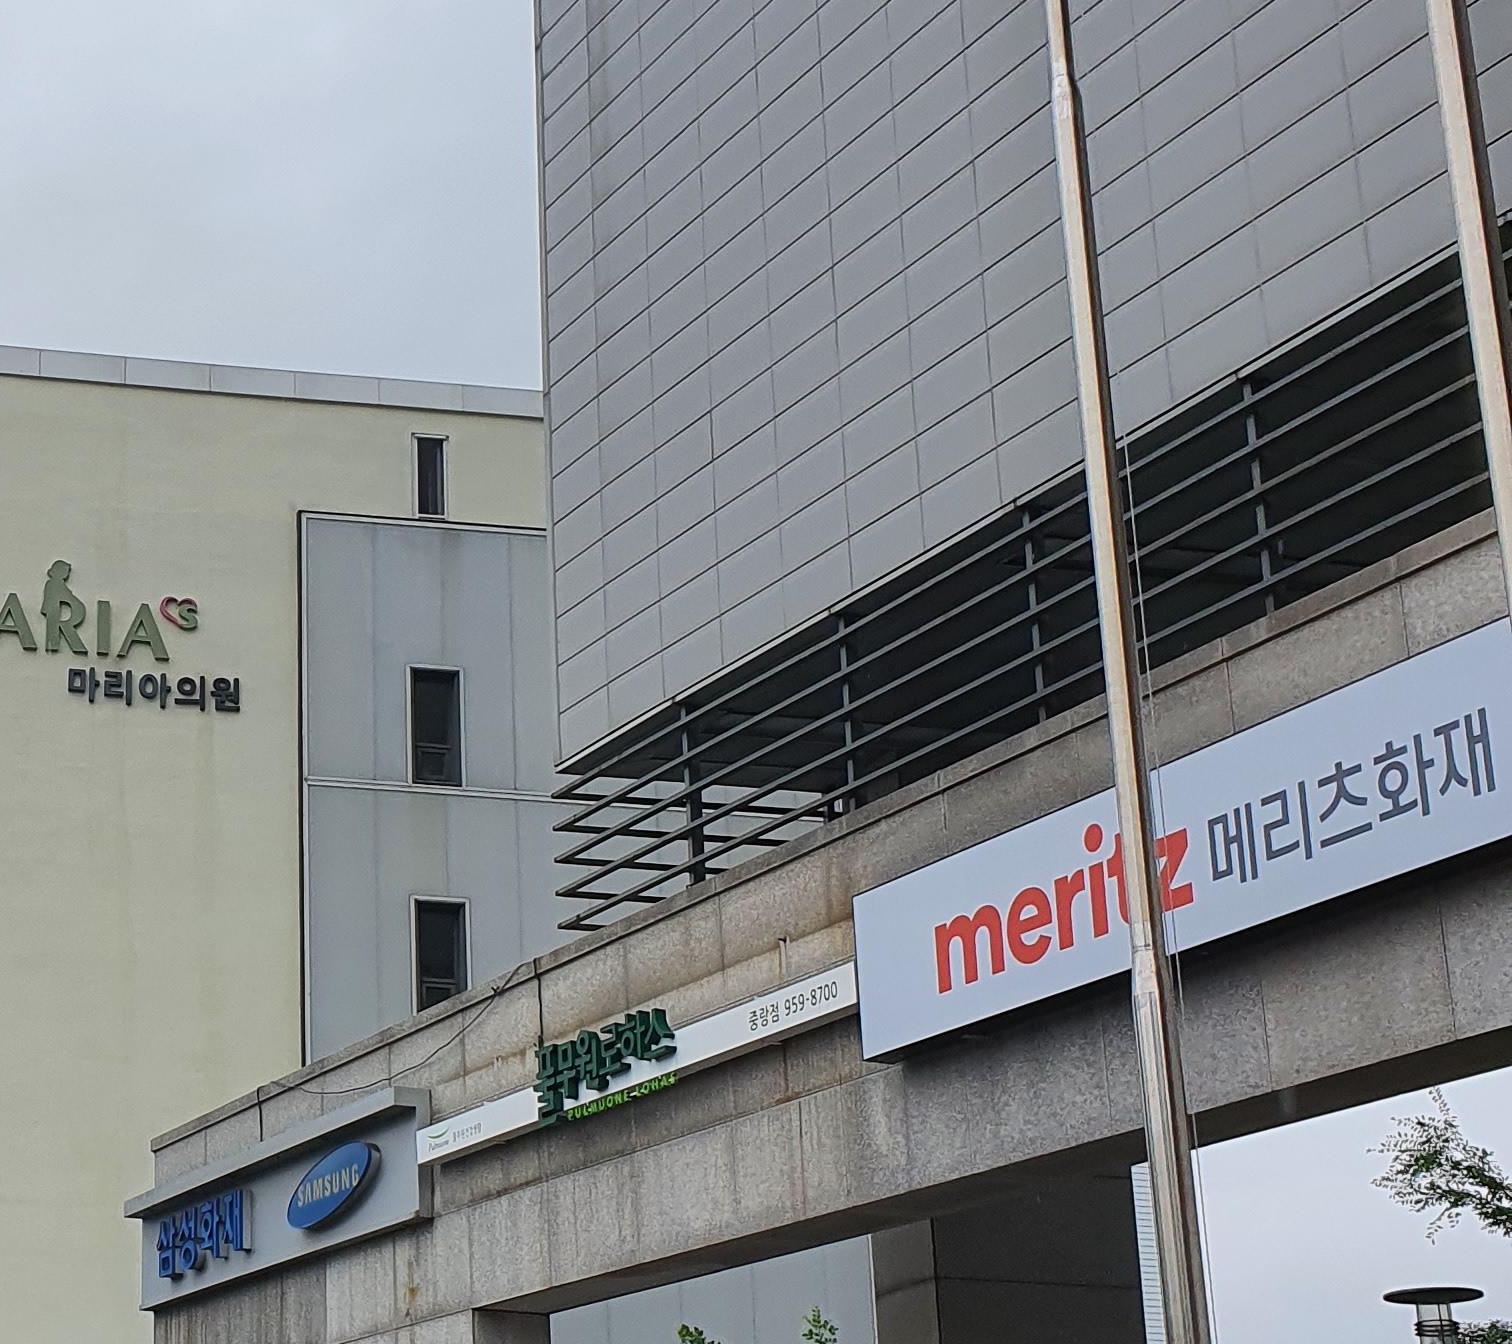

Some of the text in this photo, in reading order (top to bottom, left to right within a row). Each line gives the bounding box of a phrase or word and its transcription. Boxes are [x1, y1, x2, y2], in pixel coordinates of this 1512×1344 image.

[68, 667, 241, 713] 마리아의원
[1207, 707, 1497, 884] 메리츠화재
[749, 980, 838, 1031] 중랑점 959-8700
[534, 1008, 678, 1125] 풀무원로하스
[156, 1163, 360, 1279] 삼성화재 SAMSUNG
